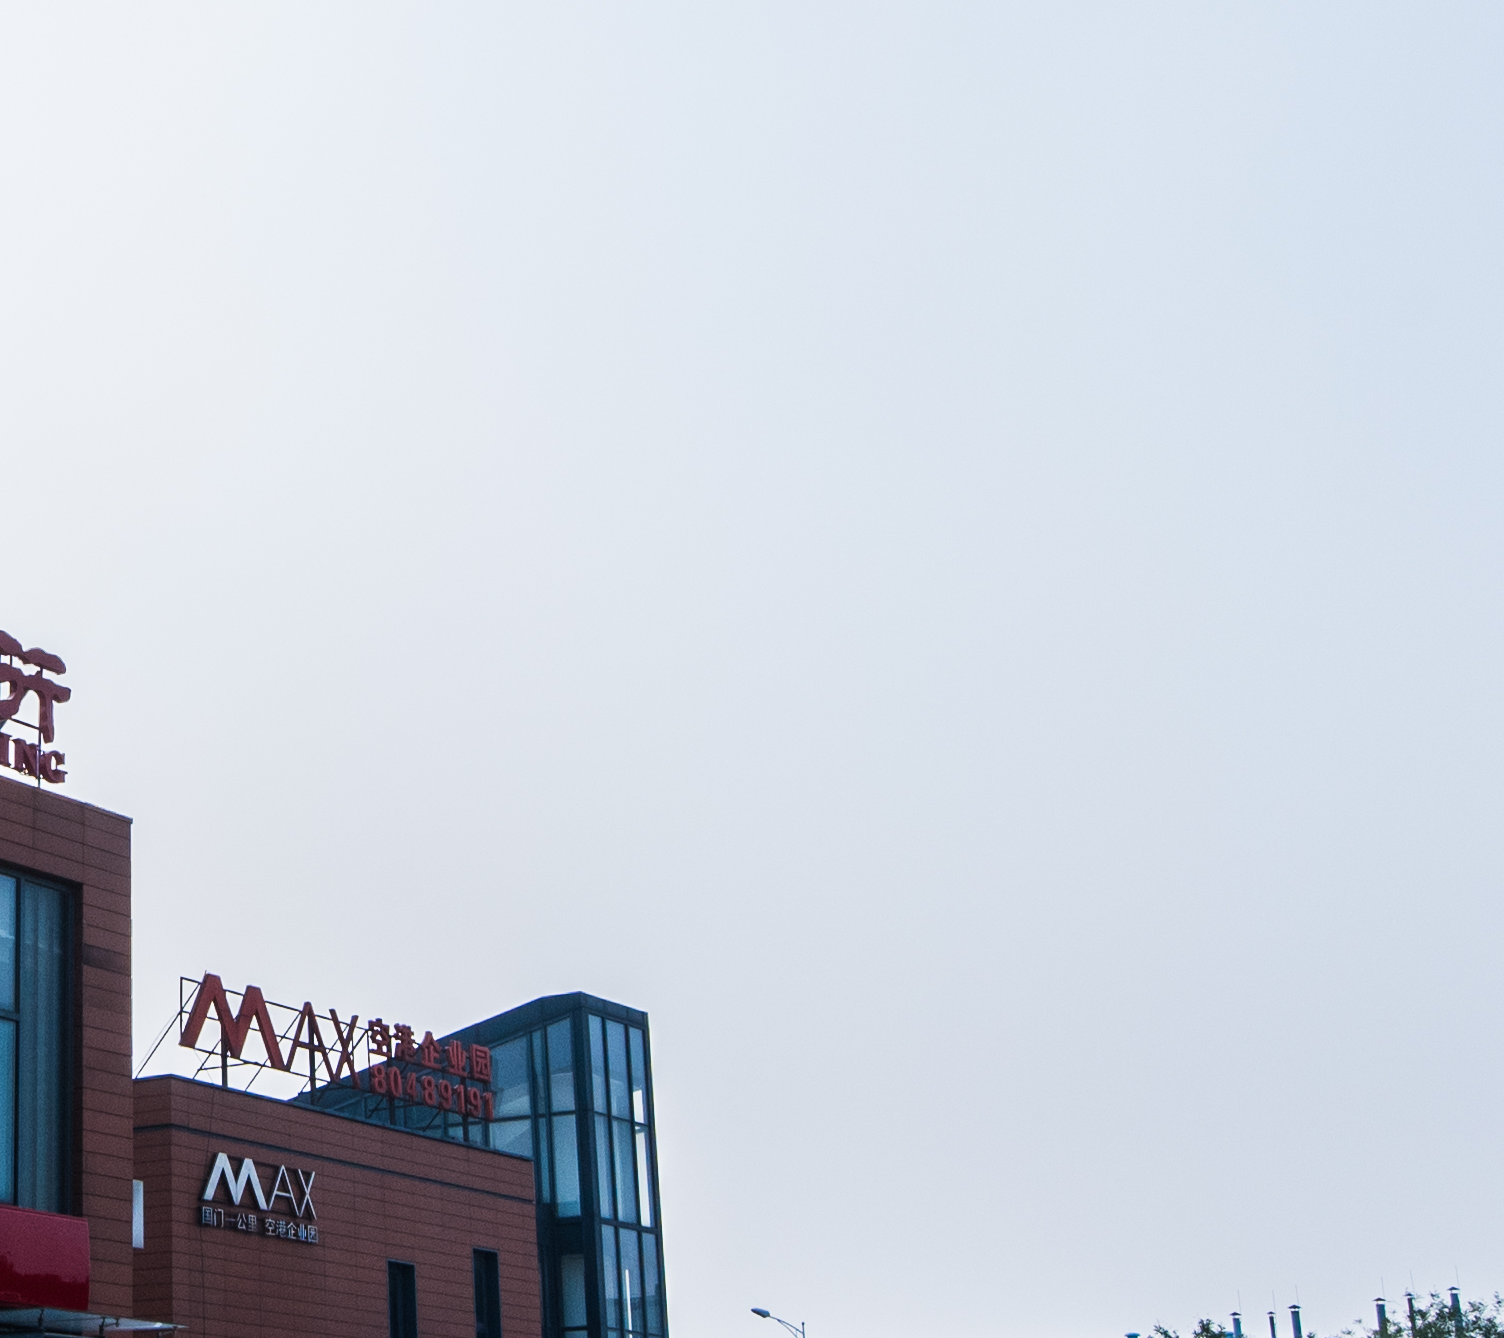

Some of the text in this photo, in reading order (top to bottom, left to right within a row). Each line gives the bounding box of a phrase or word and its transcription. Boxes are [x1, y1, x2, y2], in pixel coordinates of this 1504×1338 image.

[179, 972, 361, 1090] MAX
[367, 1018, 492, 1083] 空港企业园
[370, 1065, 494, 1121] 80489191
[202, 1151, 317, 1220] MAX
